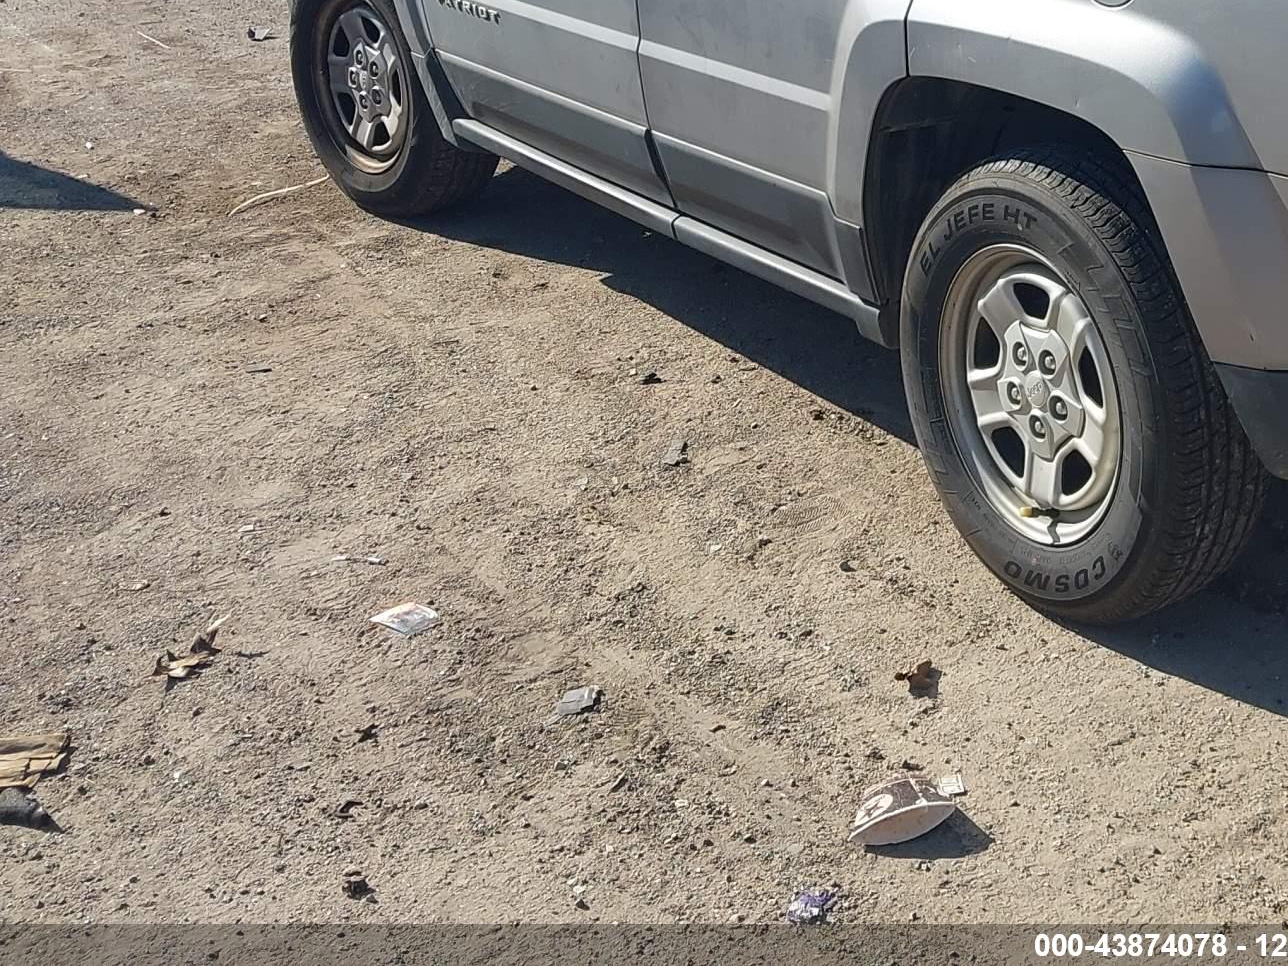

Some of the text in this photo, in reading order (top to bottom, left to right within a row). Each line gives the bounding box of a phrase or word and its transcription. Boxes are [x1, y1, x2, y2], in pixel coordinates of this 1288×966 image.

[920, 203, 1038, 276] EL JEFE HT
[1003, 556, 1107, 594] COSMO
